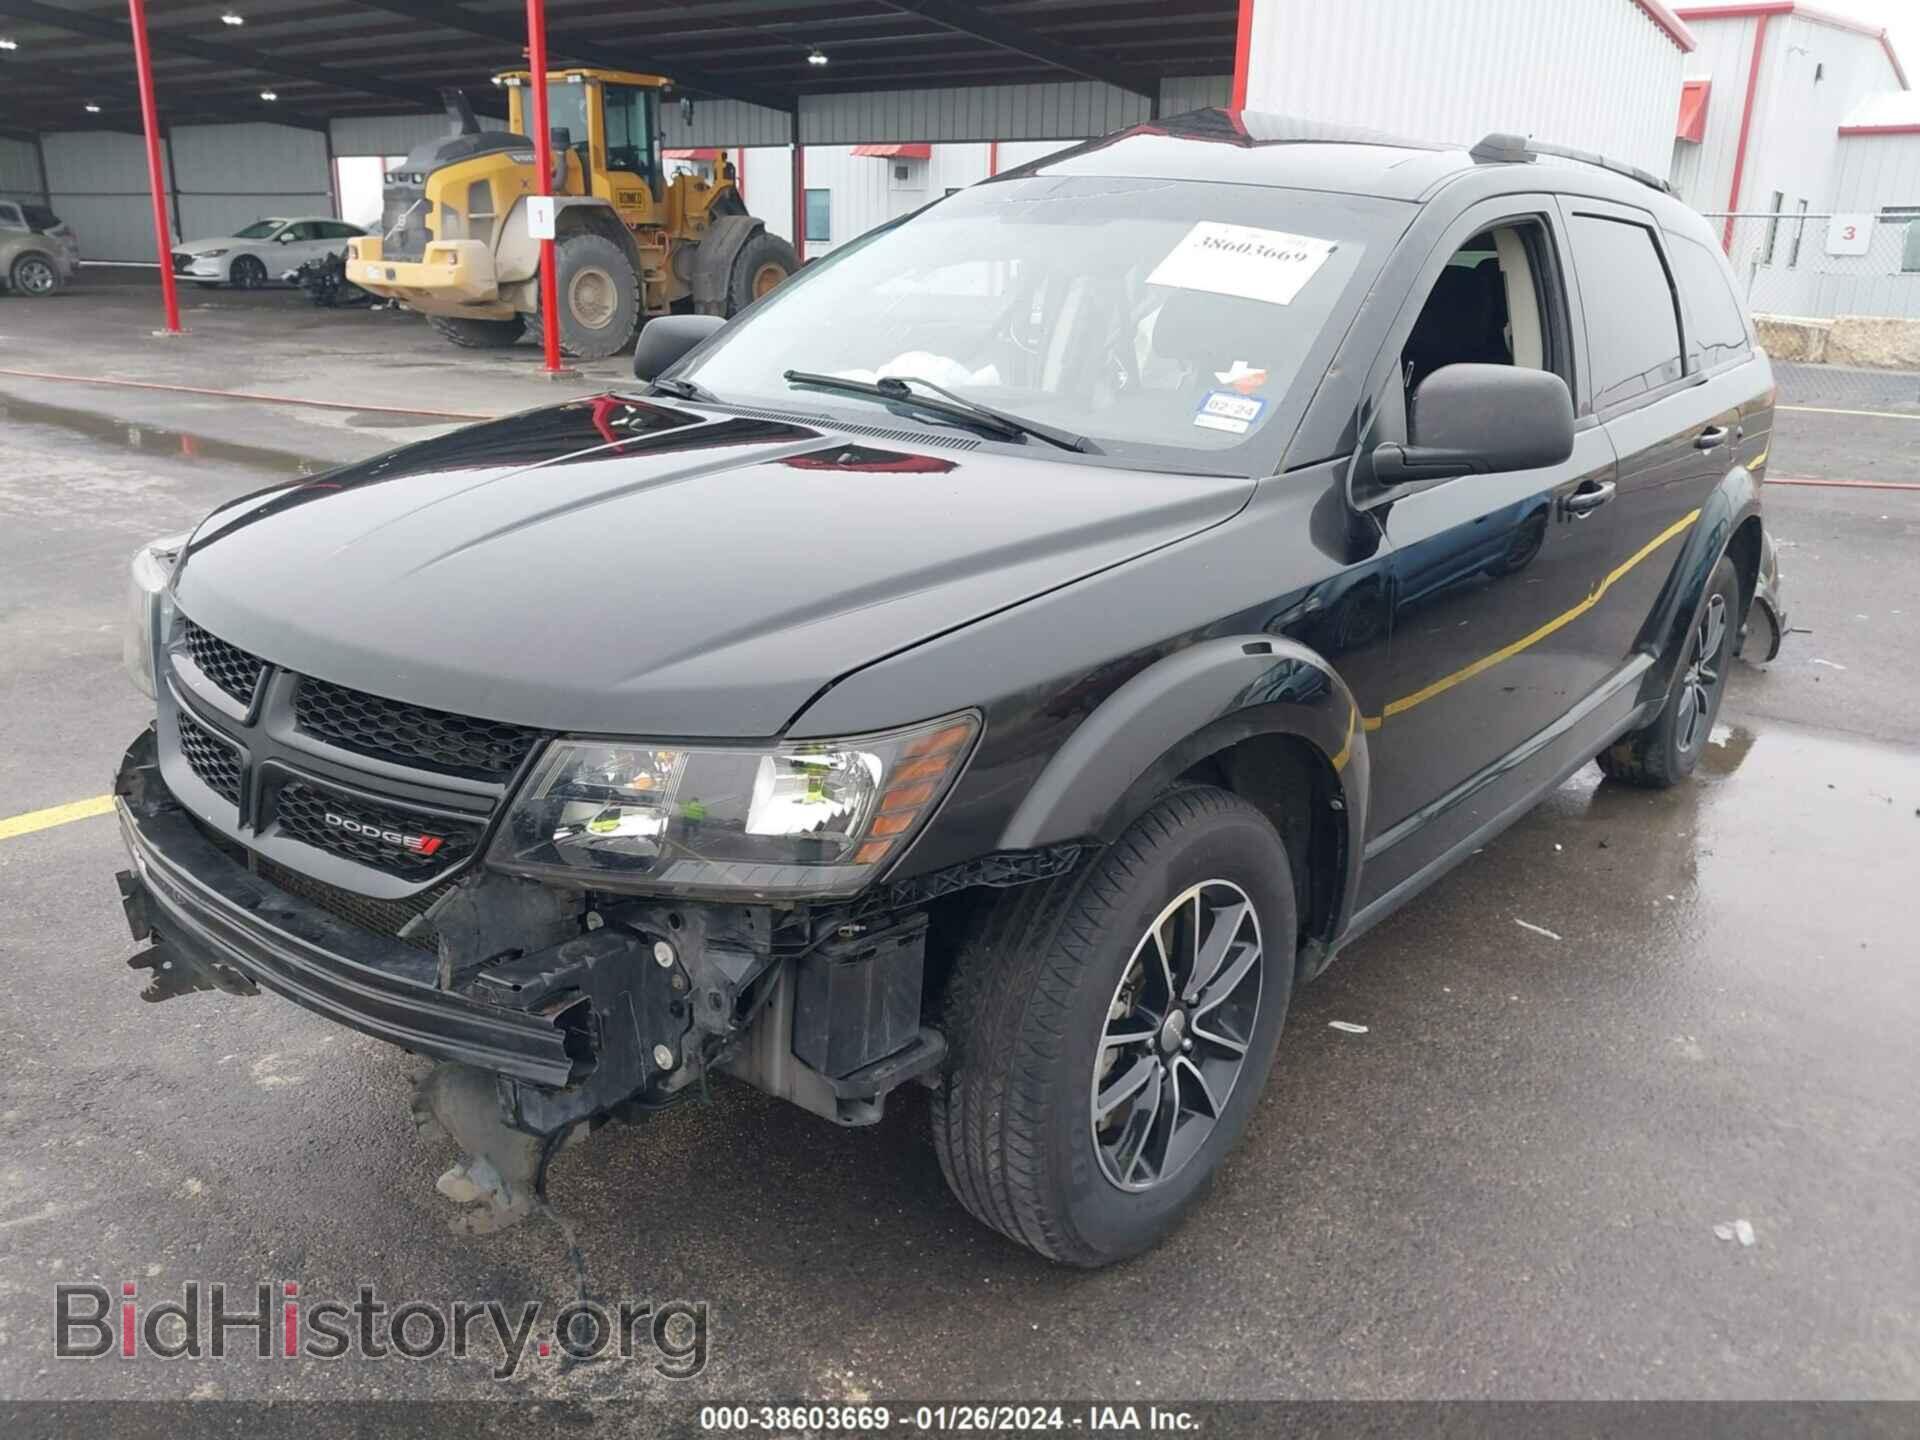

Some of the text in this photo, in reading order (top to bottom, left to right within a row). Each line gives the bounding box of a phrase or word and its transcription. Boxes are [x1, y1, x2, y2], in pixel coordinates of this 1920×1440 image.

[1842, 225, 1856, 241] 3
[1193, 236, 1308, 263] 38603669
[325, 812, 424, 850] DODGE
